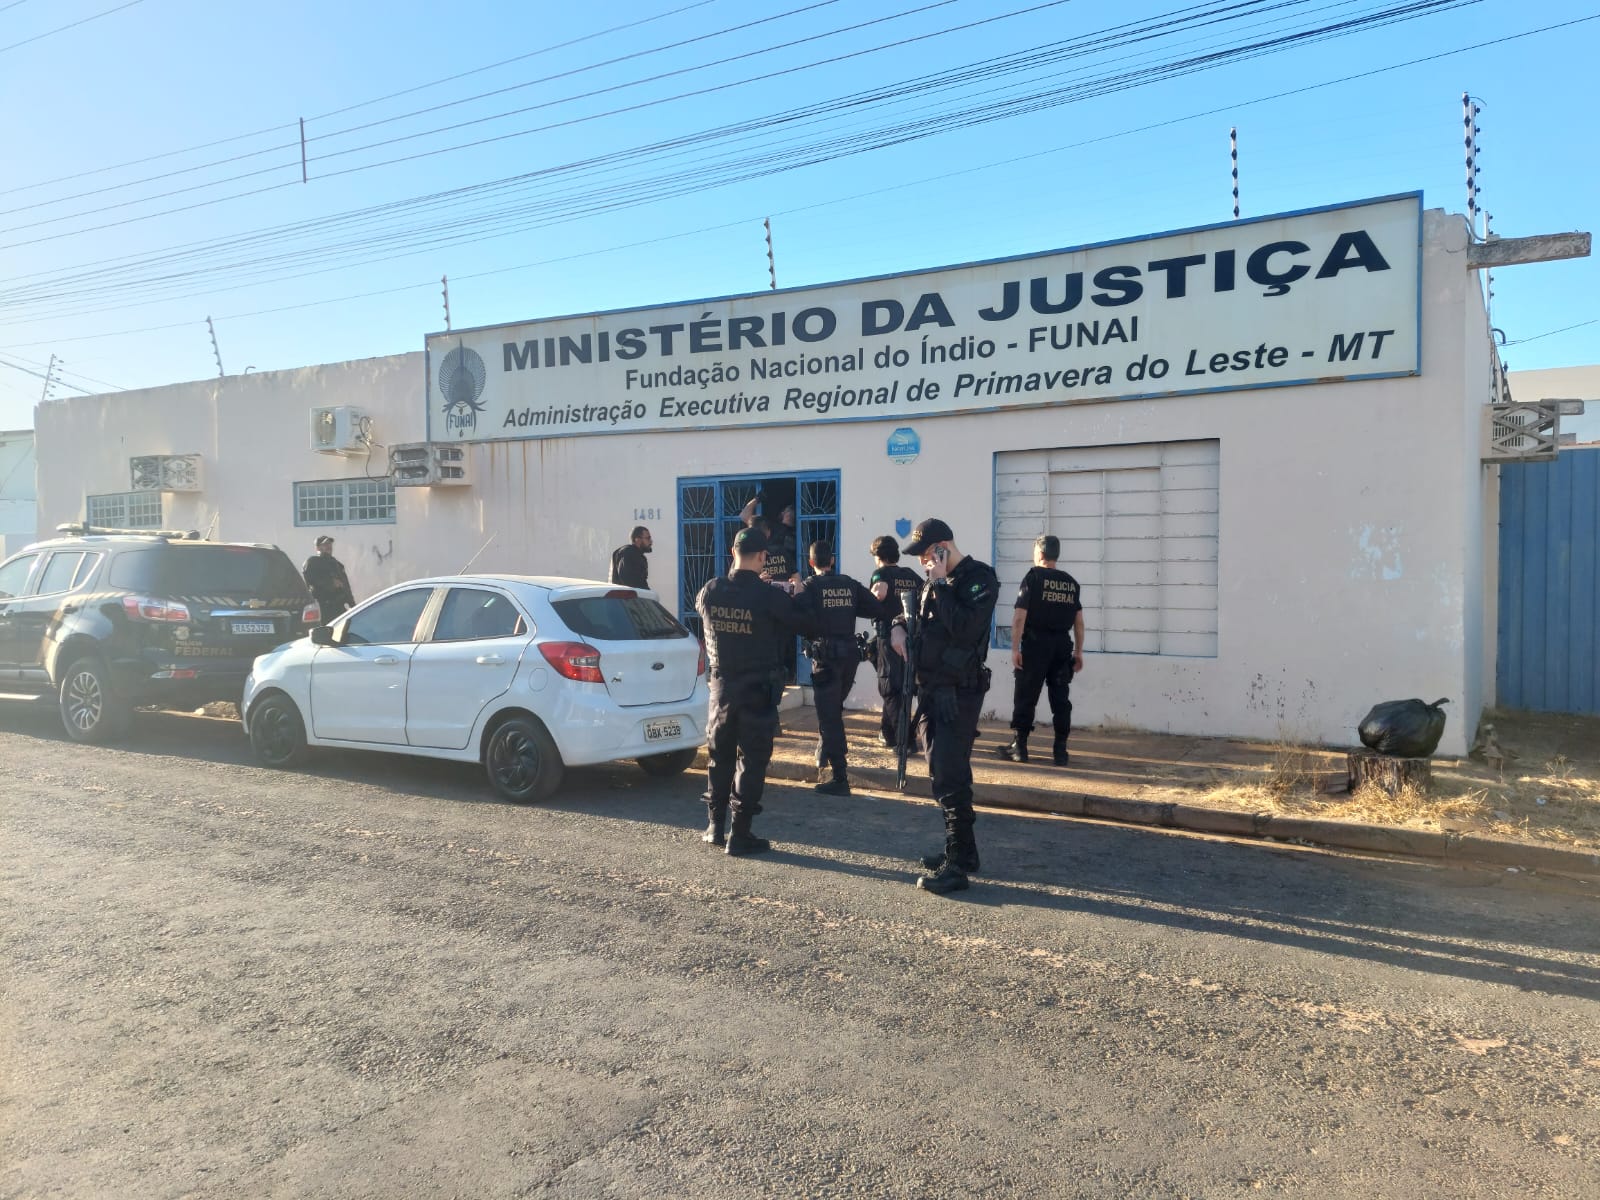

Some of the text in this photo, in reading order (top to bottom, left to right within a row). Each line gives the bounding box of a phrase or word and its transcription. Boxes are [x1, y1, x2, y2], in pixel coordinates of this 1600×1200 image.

[502, 229, 1392, 372] MINISTÉRIO DA JUSTIÇA
[625, 315, 1139, 391] Fundação Nacional do Índio - FUNAI
[502, 329, 1396, 428] Administração Executiva Regional de Primavera do Leste - MT
[449, 412, 473, 429] FUNAI
[1043, 579, 1076, 592] POLICIA
[822, 588, 852, 598] POLICIA
[1042, 591, 1075, 604] FEDERAL
[823, 598, 853, 608] FEDERAL
[710, 606, 752, 621] POLICIA
[711, 621, 752, 634] FEDERAL
